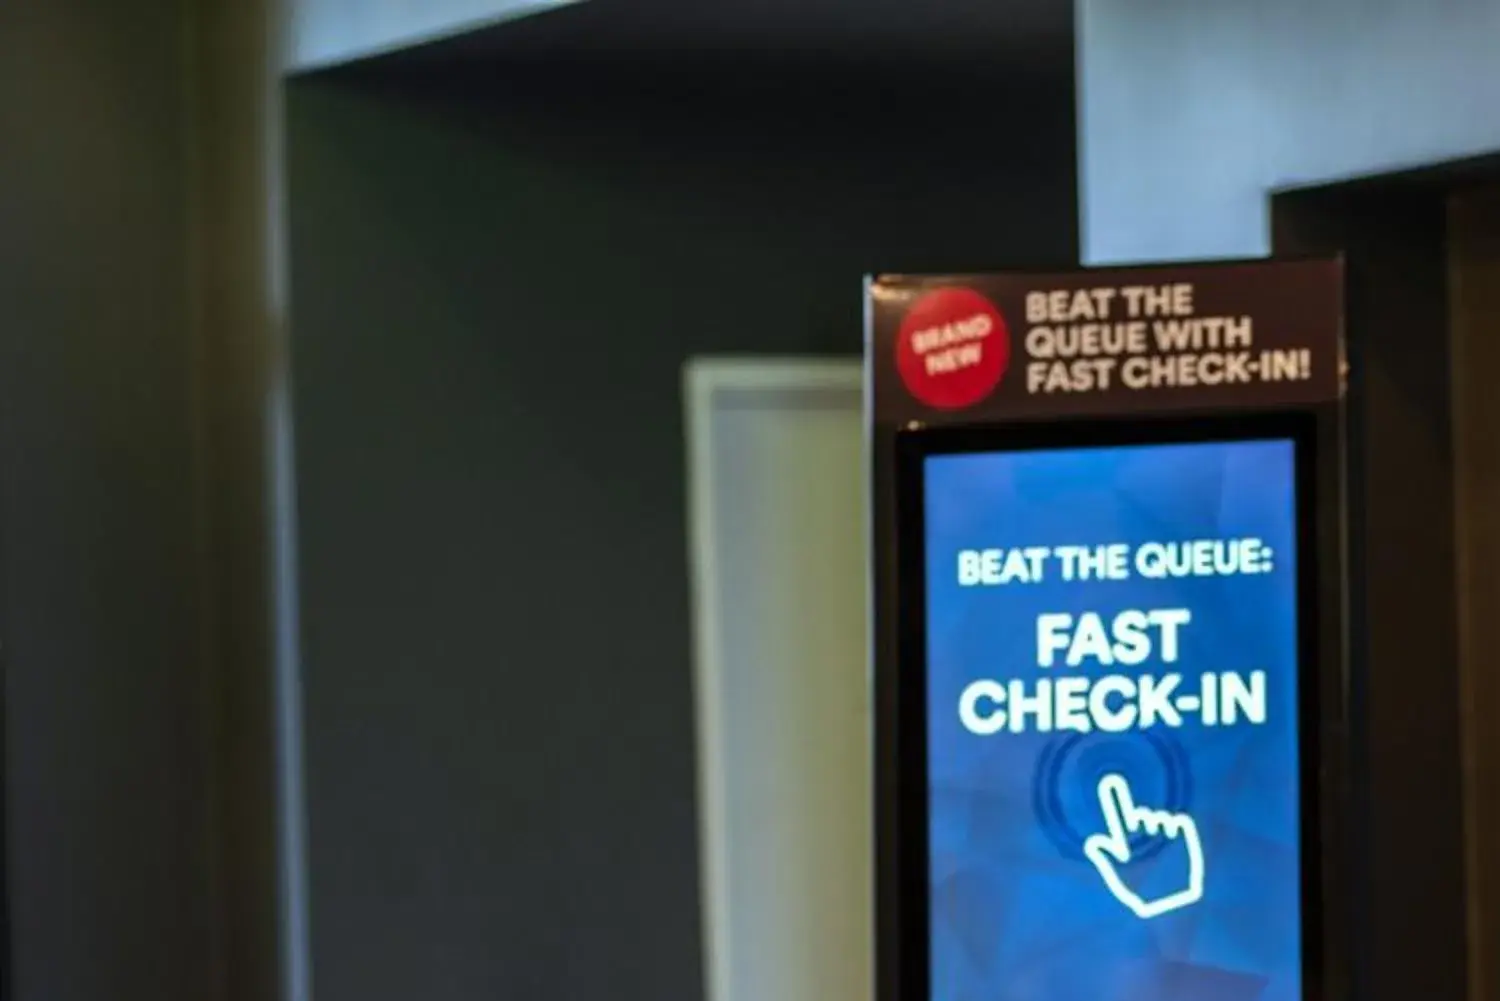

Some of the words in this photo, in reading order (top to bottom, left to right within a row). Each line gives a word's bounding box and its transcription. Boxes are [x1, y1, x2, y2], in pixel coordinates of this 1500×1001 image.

[1027, 289, 1115, 322] BEAT
[1122, 285, 1192, 316] THE
[911, 314, 992, 355] BRAND
[1026, 321, 1146, 359] QUEUE
[1154, 318, 1251, 348] WITH
[925, 341, 982, 376] NEW
[1028, 359, 1115, 392] FAST
[1123, 350, 1309, 388] CHECK-IN!
[959, 547, 1050, 585] BEAT
[1054, 544, 1128, 580] THE
[1135, 539, 1272, 577] QUEUE:
[1037, 609, 1190, 667] FAST
[959, 670, 1266, 735] CHECK-IN
